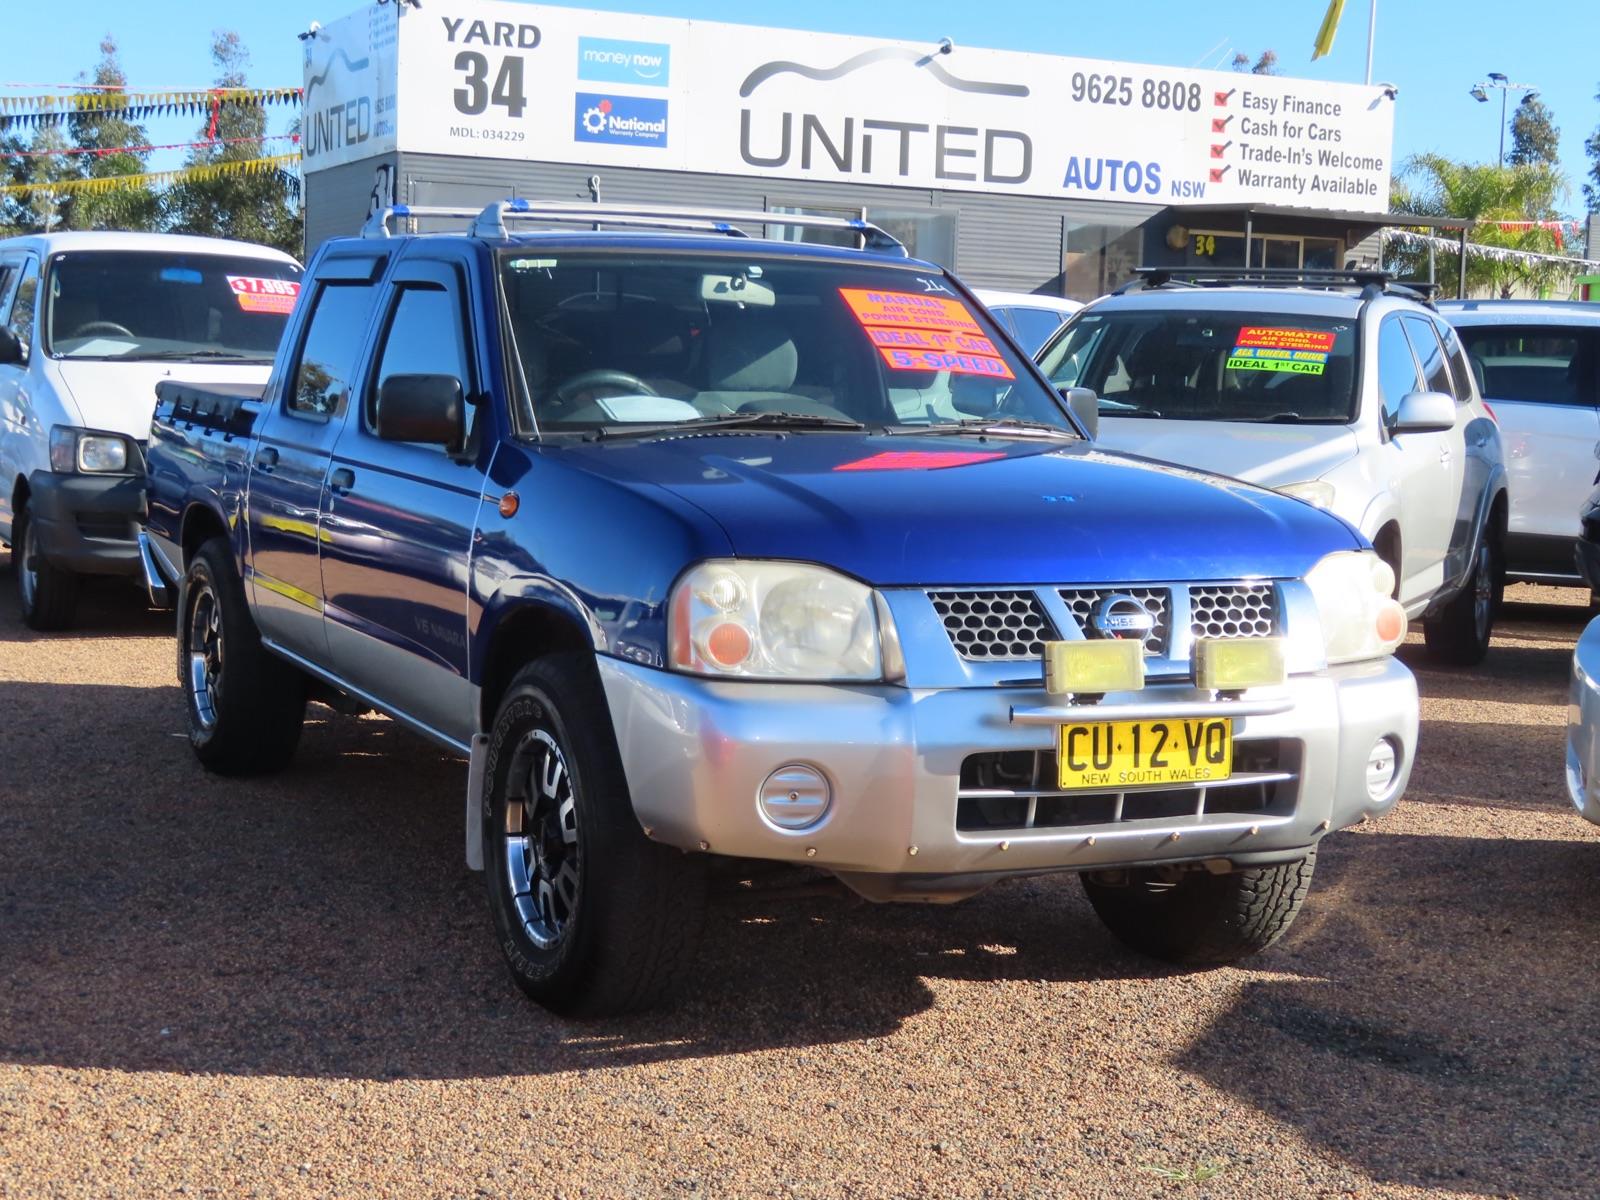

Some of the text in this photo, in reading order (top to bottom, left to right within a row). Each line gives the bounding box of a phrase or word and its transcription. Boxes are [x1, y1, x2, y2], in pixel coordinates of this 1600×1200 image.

[441, 16, 542, 50] YARD
[584, 49, 662, 68] money now
[453, 50, 527, 119] 34
[1071, 72, 1202, 112] 9625 8808
[1242, 91, 1342, 117] Easy Finance
[306, 96, 370, 157] UNITED
[449, 126, 526, 143] MDL: 034229
[608, 115, 665, 133] National
[609, 128, 659, 140] Warranty Company
[1241, 117, 1342, 143] Cash for Cars
[740, 109, 1032, 184] UNITED
[1239, 143, 1383, 172] Trade-In's Welcome
[1063, 156, 1206, 199] AUTOS NSW
[1238, 169, 1378, 196] Warranty Available
[1195, 235, 1216, 256] 34
[867, 293, 945, 309] MANUAL
[862, 313, 977, 329] POWER STEERING
[872, 329, 930, 346] IDEAL
[955, 336, 993, 352] CAR
[1247, 329, 1328, 341] AUTOMATIC
[1279, 341, 1329, 350] STEERING
[892, 352, 1005, 374] 5-SPEED
[1229, 359, 1269, 369] IDEAL
[1291, 363, 1321, 373] CAR
[1105, 617, 1147, 628] NISS
[1082, 768, 1211, 785] NEW SOUTH WALES
